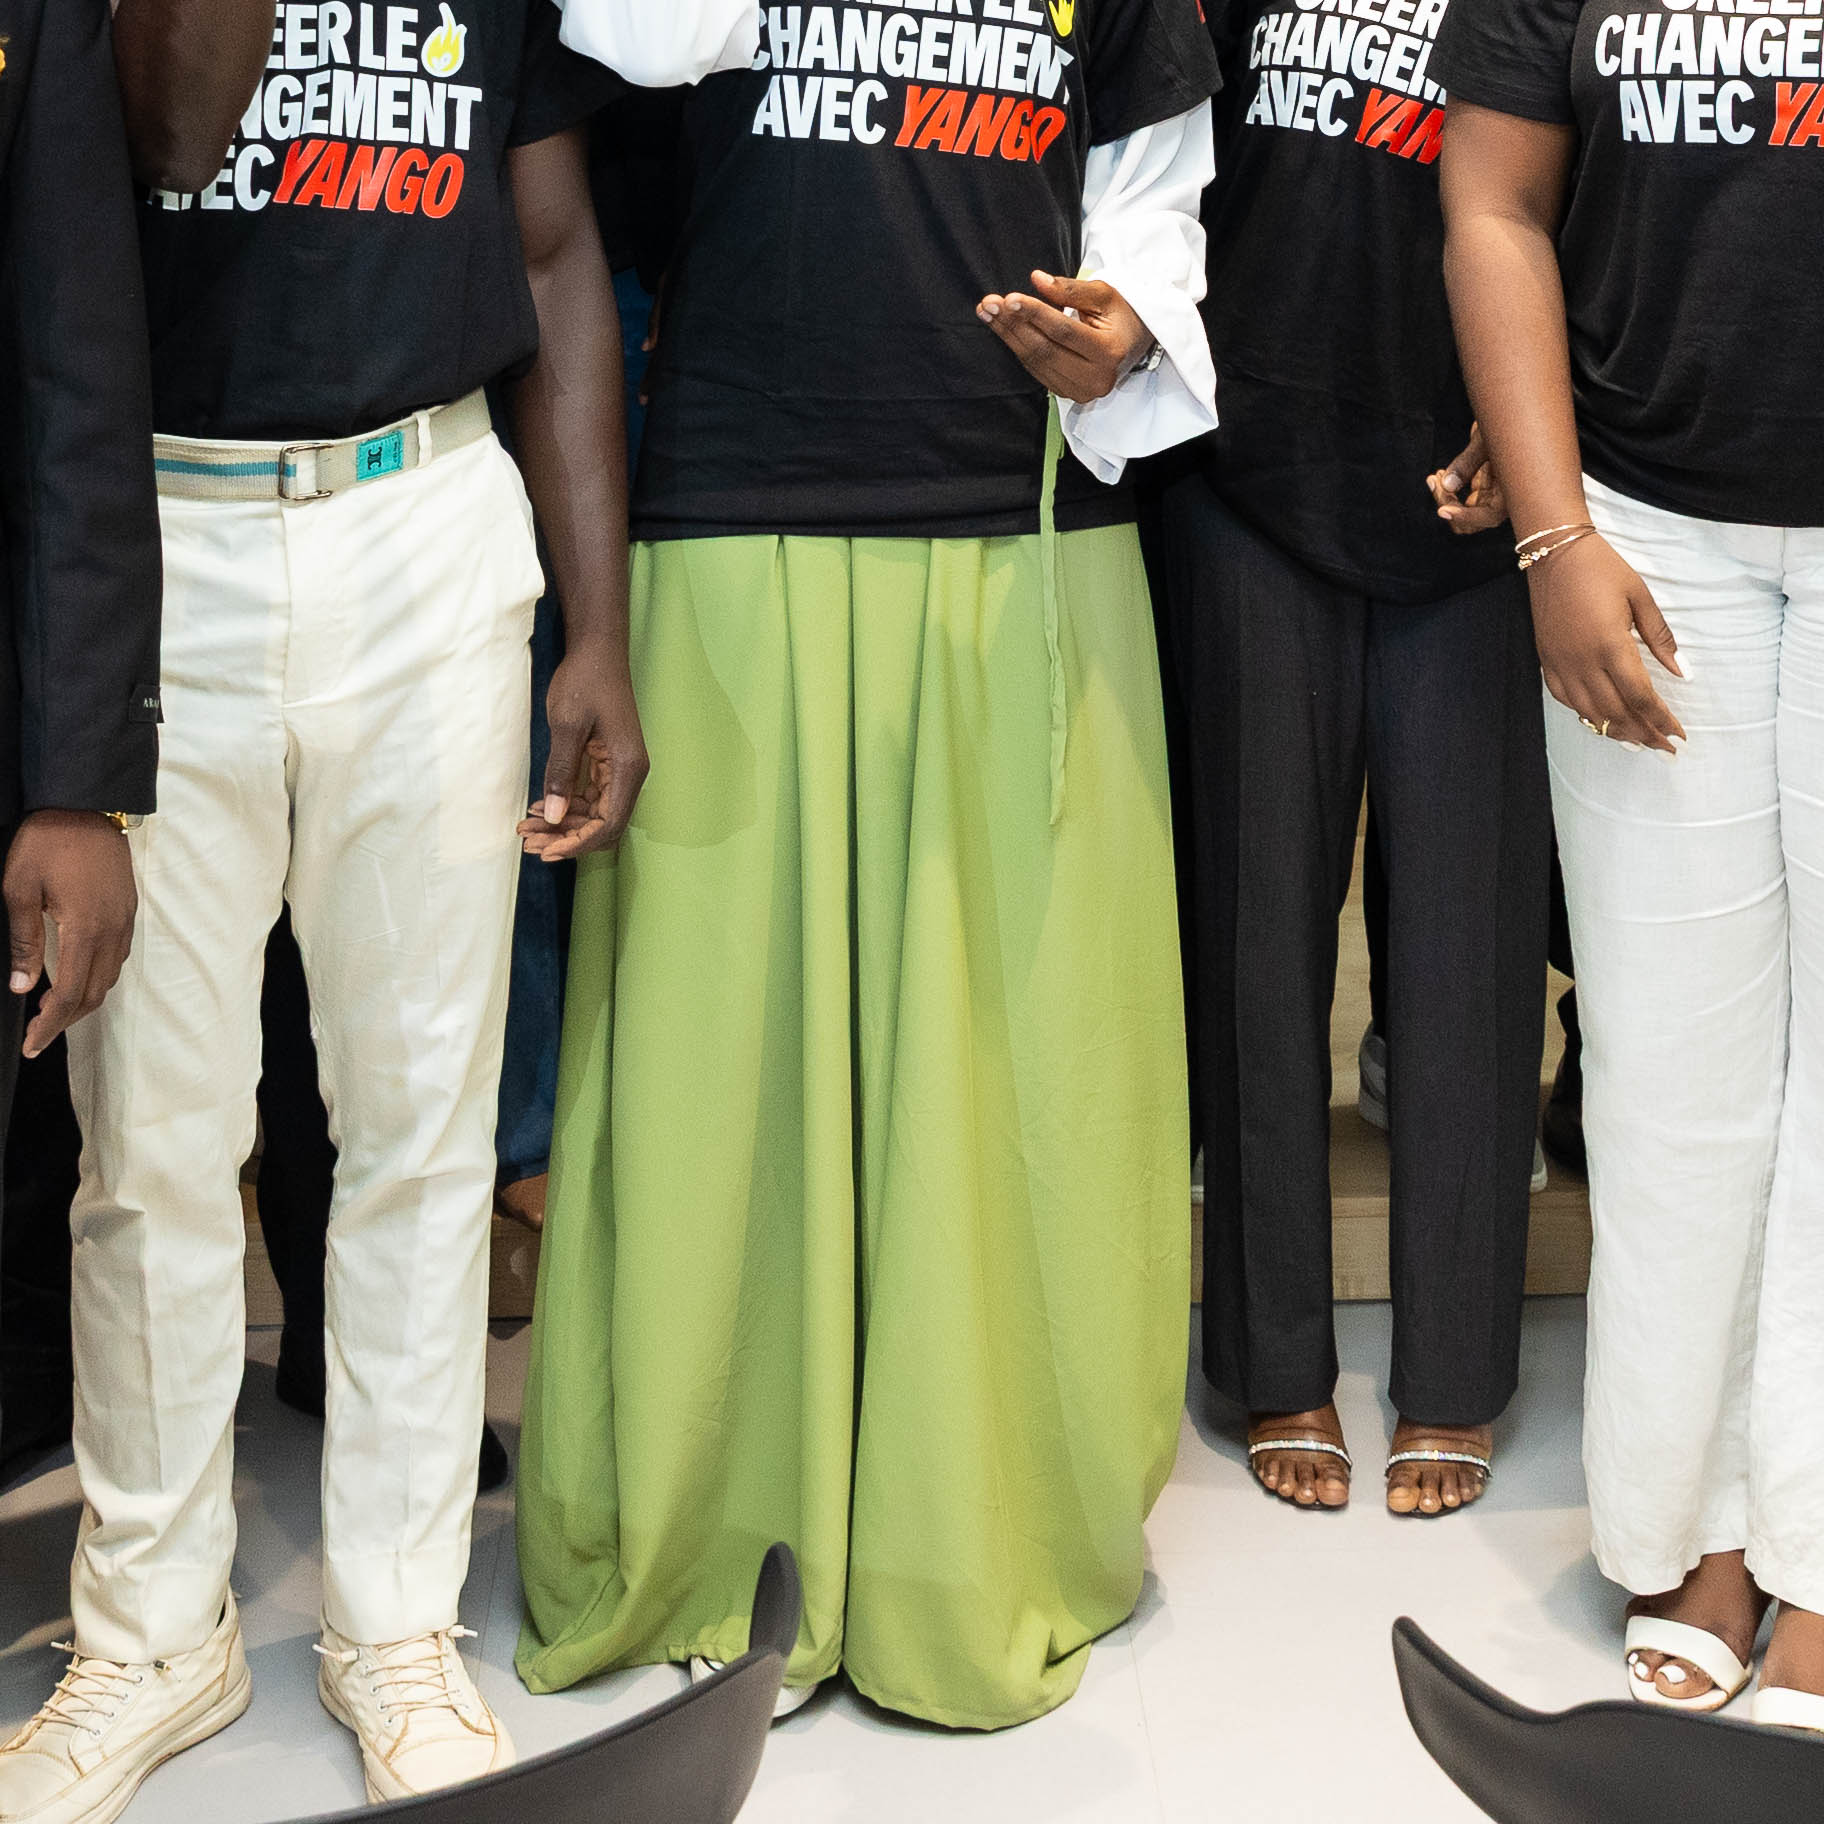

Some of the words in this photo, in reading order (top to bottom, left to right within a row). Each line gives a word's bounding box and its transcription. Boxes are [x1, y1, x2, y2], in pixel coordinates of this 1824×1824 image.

[359, 2, 419, 72] LE
[751, 74, 889, 144] AVEC
[893, 84, 1066, 164] YANGO
[1245, 70, 1355, 136] AVEC
[1619, 79, 1756, 145] AVEC
[273, 139, 465, 219] YANGO
